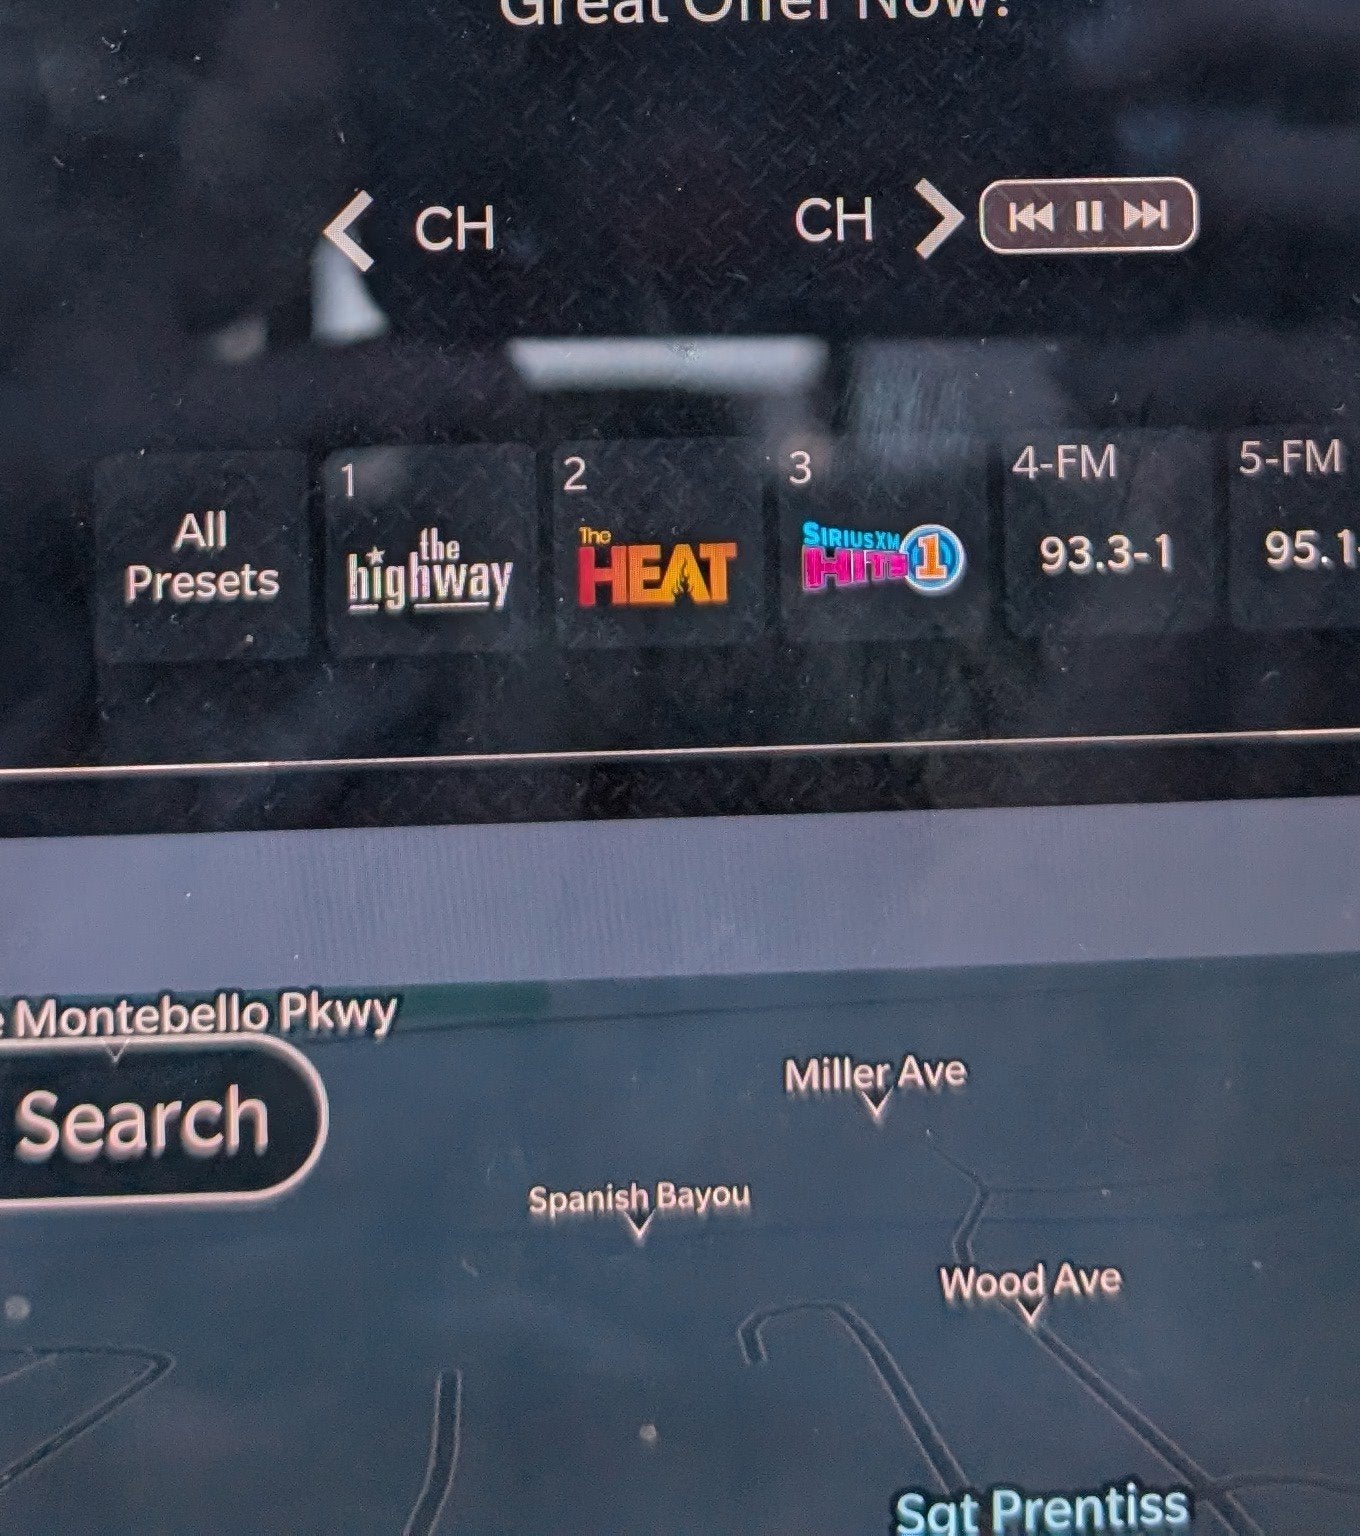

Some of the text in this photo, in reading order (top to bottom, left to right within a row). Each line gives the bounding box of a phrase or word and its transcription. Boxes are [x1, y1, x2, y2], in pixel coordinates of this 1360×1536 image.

[414, 204, 495, 253] CH
[794, 196, 874, 242] CH
[562, 456, 588, 492] 2
[788, 449, 813, 485] 3
[1012, 442, 1118, 480] 4-FM
[1238, 437, 1343, 475] 5-FM
[341, 463, 356, 498] 1
[172, 509, 228, 551] All
[419, 526, 462, 562] the
[578, 525, 613, 545] The
[802, 532, 947, 591] HITS 1
[1040, 532, 1175, 574] 93.3-1
[124, 561, 281, 604] Presets
[347, 545, 515, 611] highway
[577, 542, 738, 607] HEAT
[15, 991, 271, 1040] Montebello
[278, 988, 398, 1041] Pkwy
[785, 1054, 969, 1093] Miller Ave
[15, 1082, 270, 1164] Search
[528, 1180, 752, 1219] Spanish Bayou
[940, 1263, 1124, 1303] Wood Ave
[991, 1480, 1190, 1536] Prentiss
